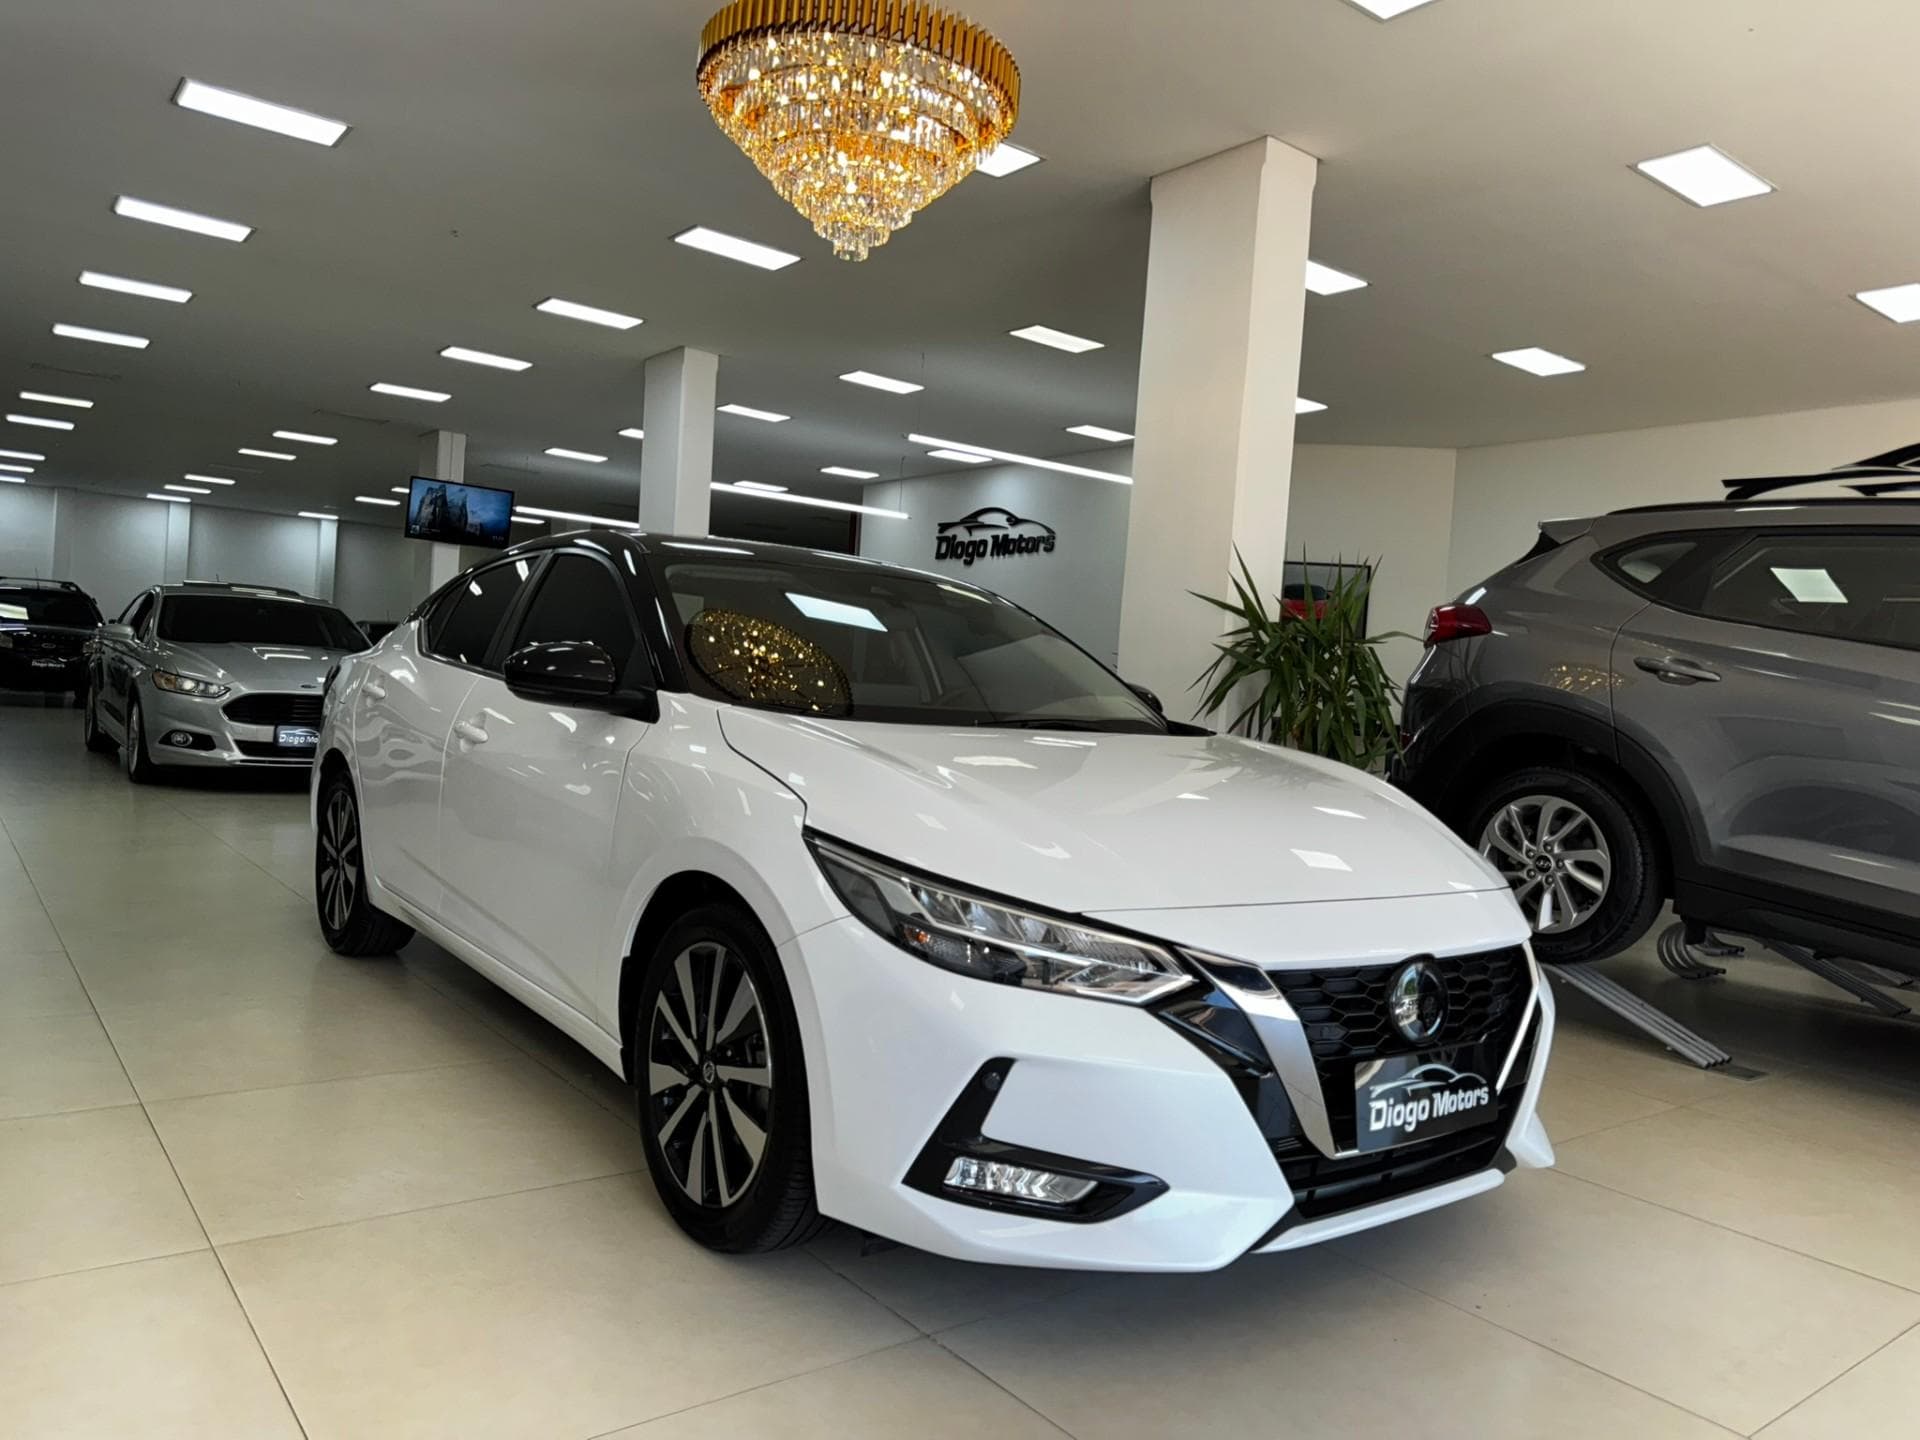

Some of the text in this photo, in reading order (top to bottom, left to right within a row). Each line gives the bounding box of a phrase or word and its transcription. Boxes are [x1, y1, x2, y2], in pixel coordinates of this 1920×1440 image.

[935, 534, 1056, 566] Diogo Motors
[1369, 1086, 1489, 1132] Diogo Motors
